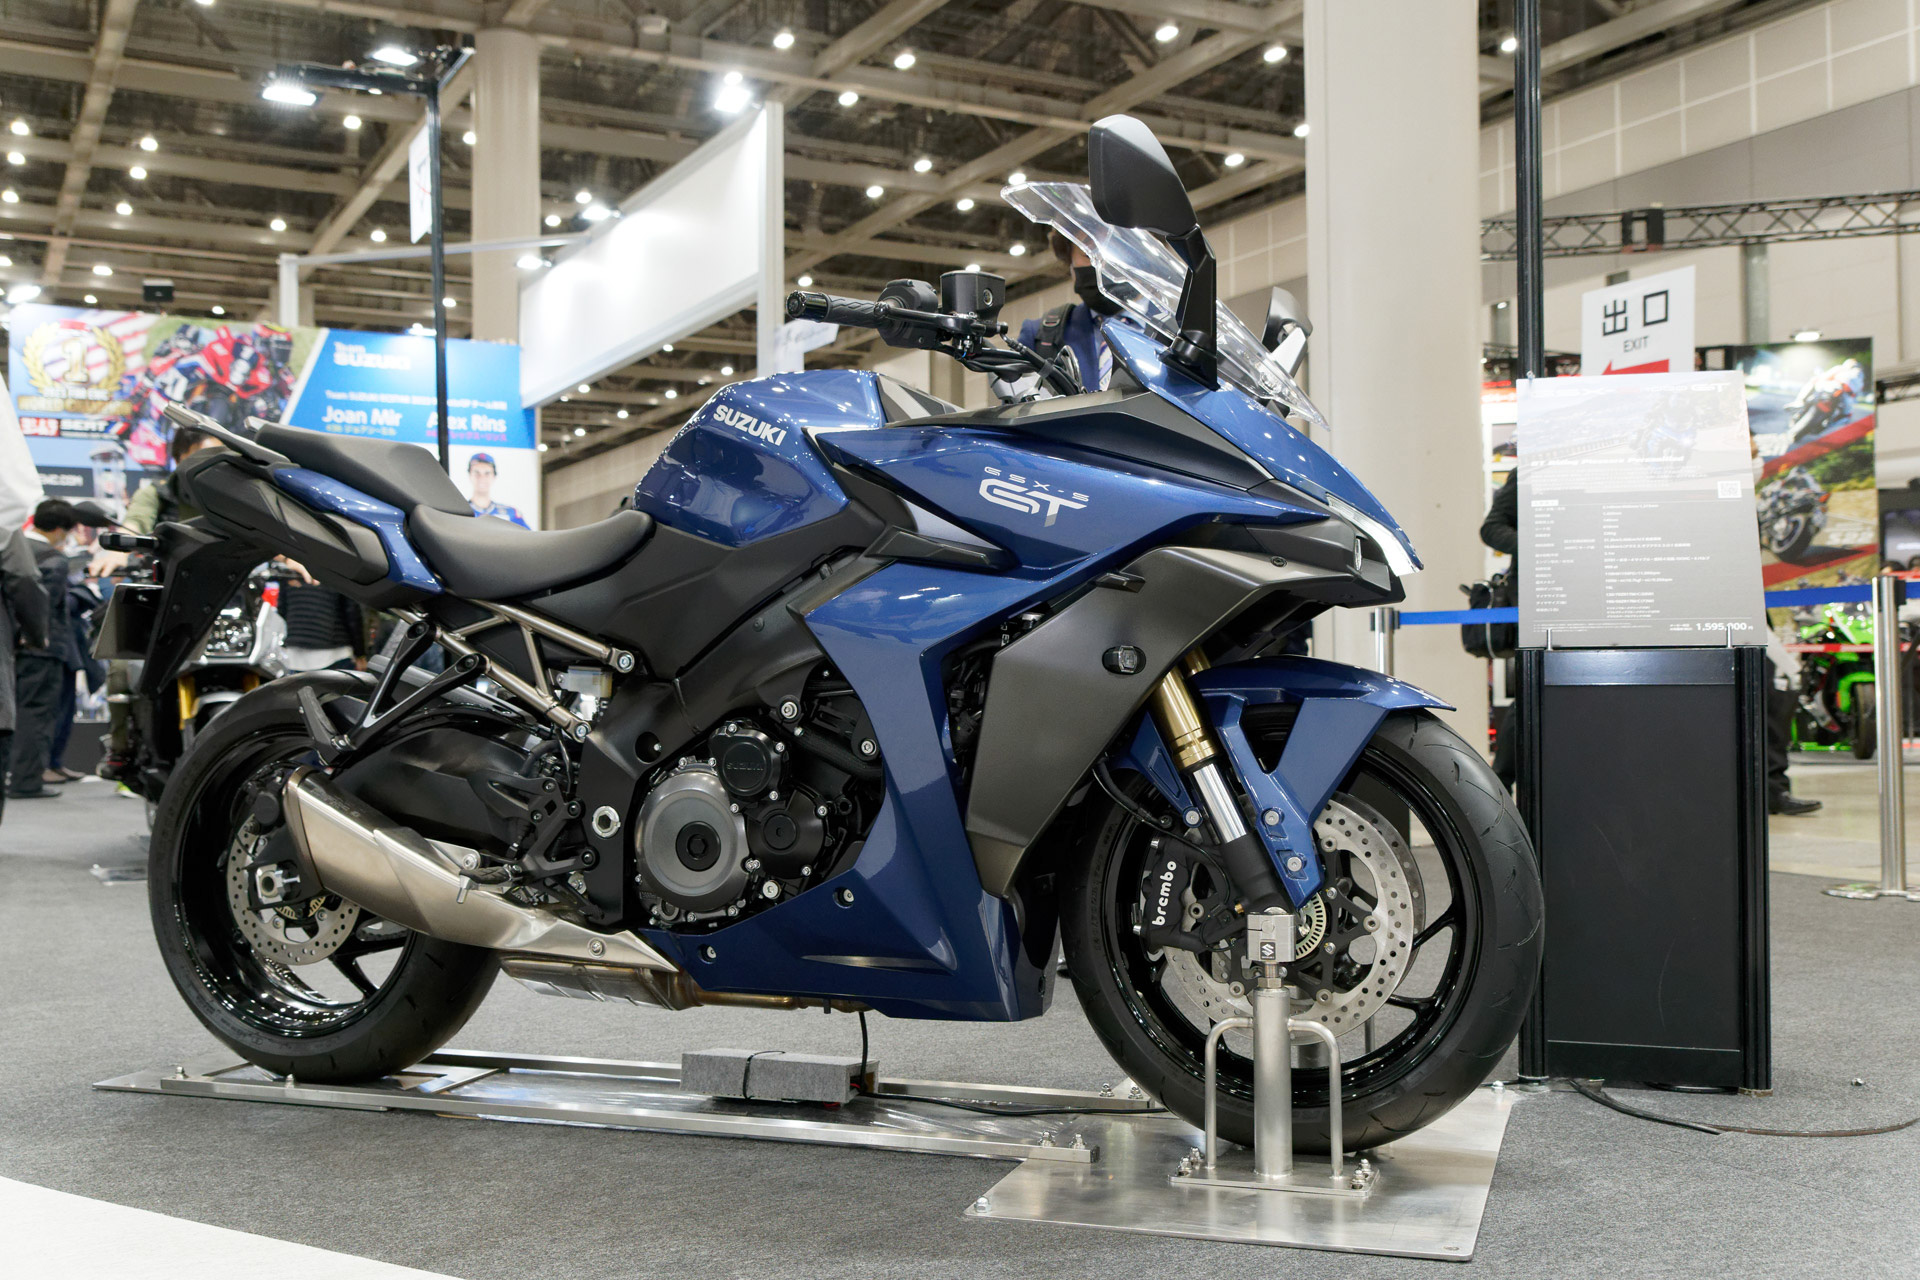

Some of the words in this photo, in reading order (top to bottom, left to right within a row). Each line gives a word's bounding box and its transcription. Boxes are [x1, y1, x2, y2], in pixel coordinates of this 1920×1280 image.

[1602, 289, 1669, 337] 出口
[1623, 335, 1650, 353] EXIT
[321, 405, 368, 425] Joan
[370, 408, 402, 427] Mir
[426, 411, 468, 431] Aex
[471, 414, 507, 433] Rins
[713, 404, 787, 446] SUZUKI
[979, 478, 1087, 527] GT
[984, 466, 1089, 502] GSX-S
[1151, 861, 1177, 926] brembo
